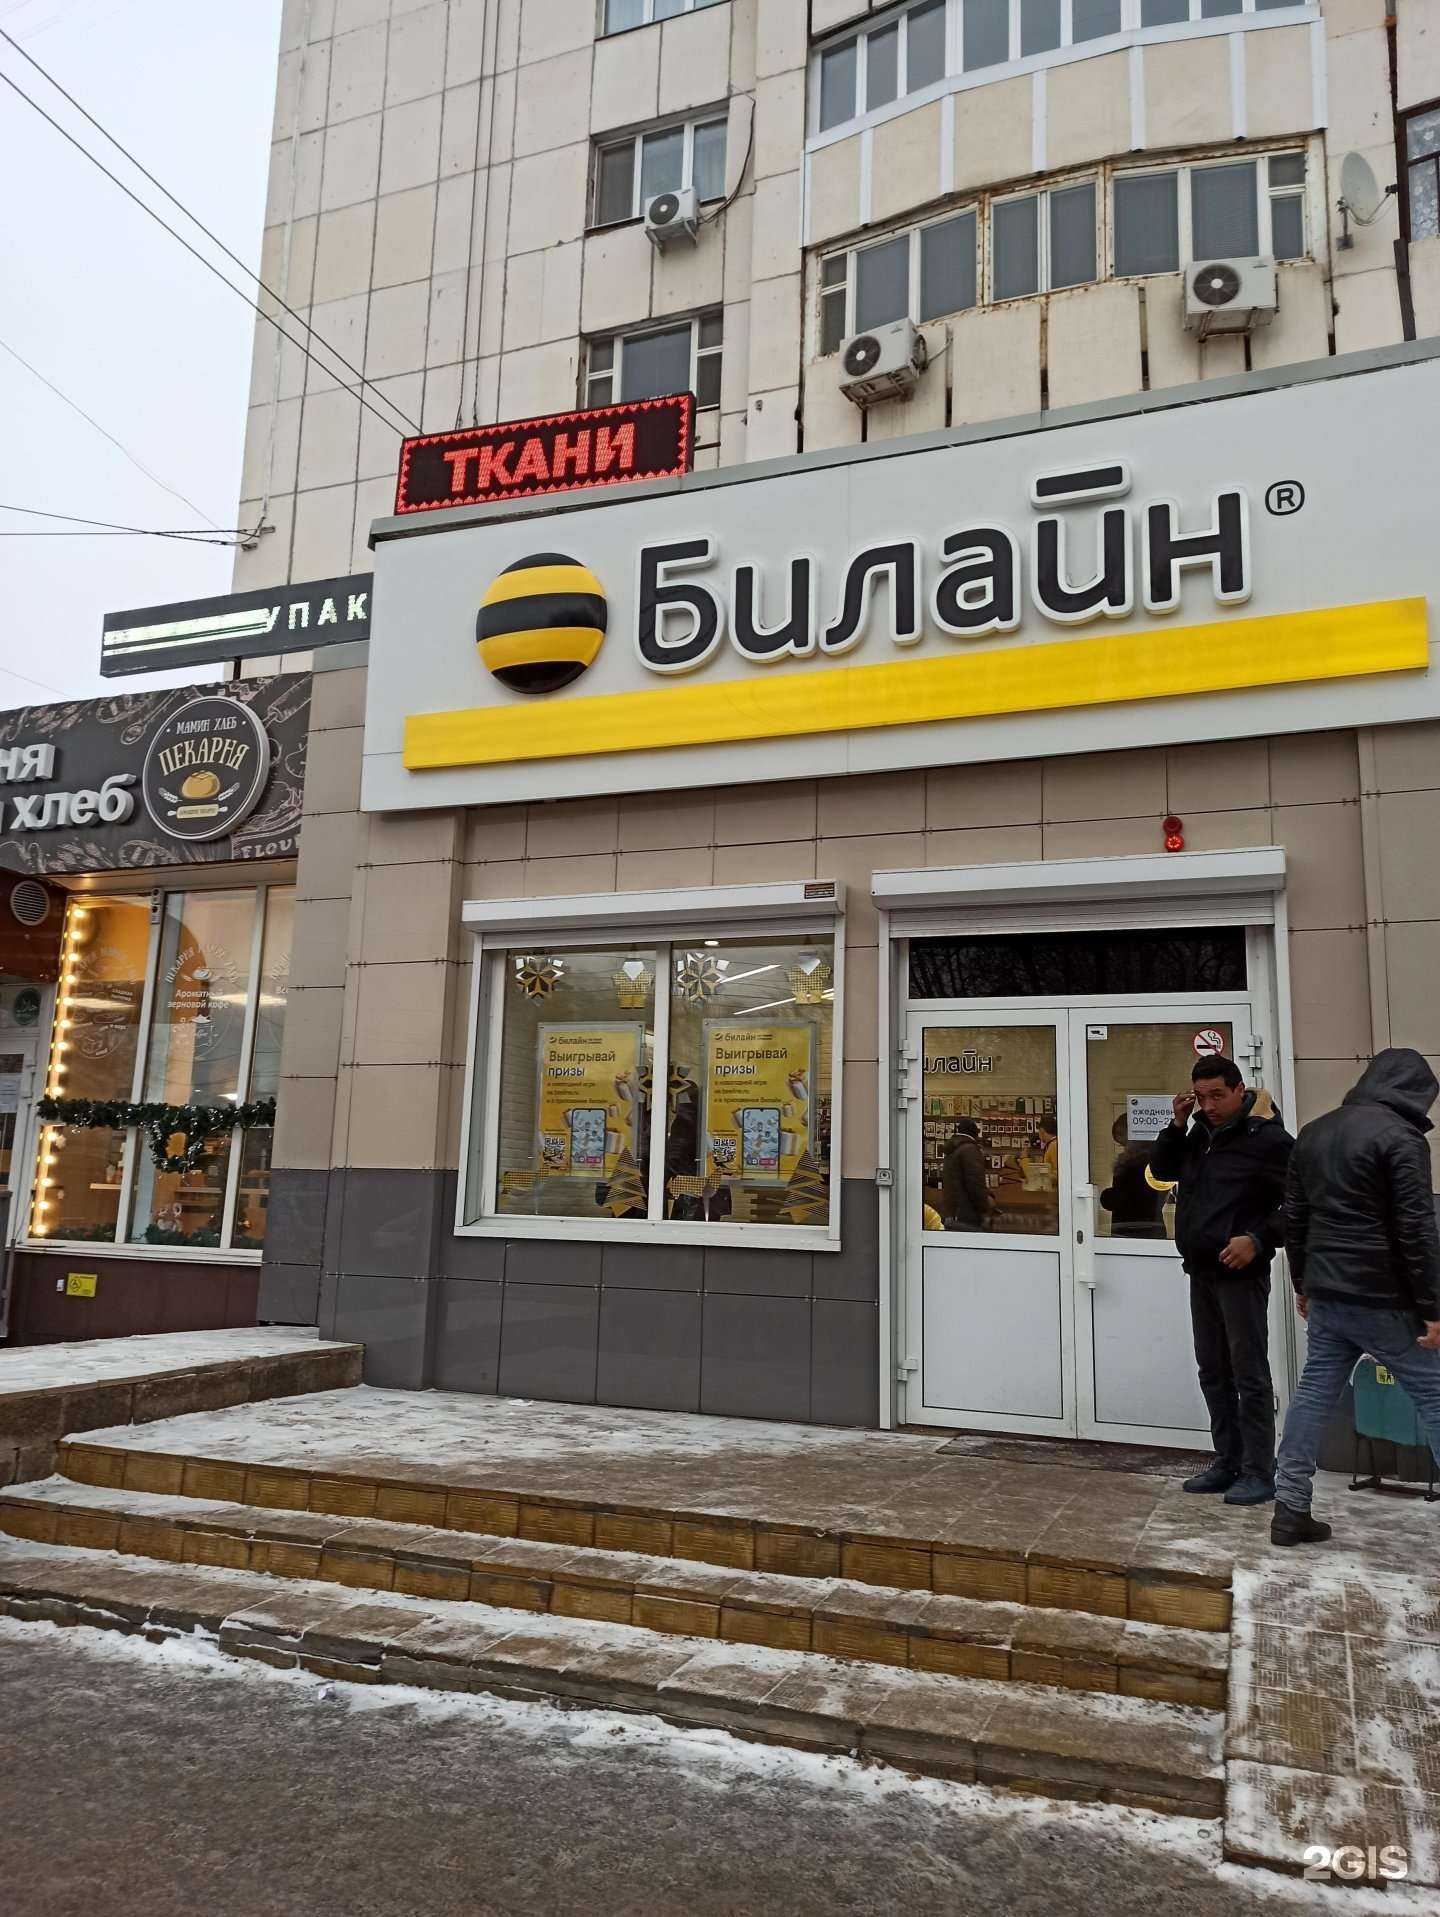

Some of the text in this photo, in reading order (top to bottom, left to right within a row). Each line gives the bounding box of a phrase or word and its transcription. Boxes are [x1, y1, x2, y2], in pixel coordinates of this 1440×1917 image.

[443, 422, 635, 493] ТКАНИ
[176, 716, 238, 735] МАМИН ХЛЕБ
[158, 737, 250, 777] ПЕКАРНЯ
[9, 773, 137, 832] хлеб
[549, 1050, 616, 1064] Выигрывай
[715, 1047, 788, 1062] Выигрывай
[548, 1067, 585, 1079] призы
[715, 1064, 755, 1077] призы
